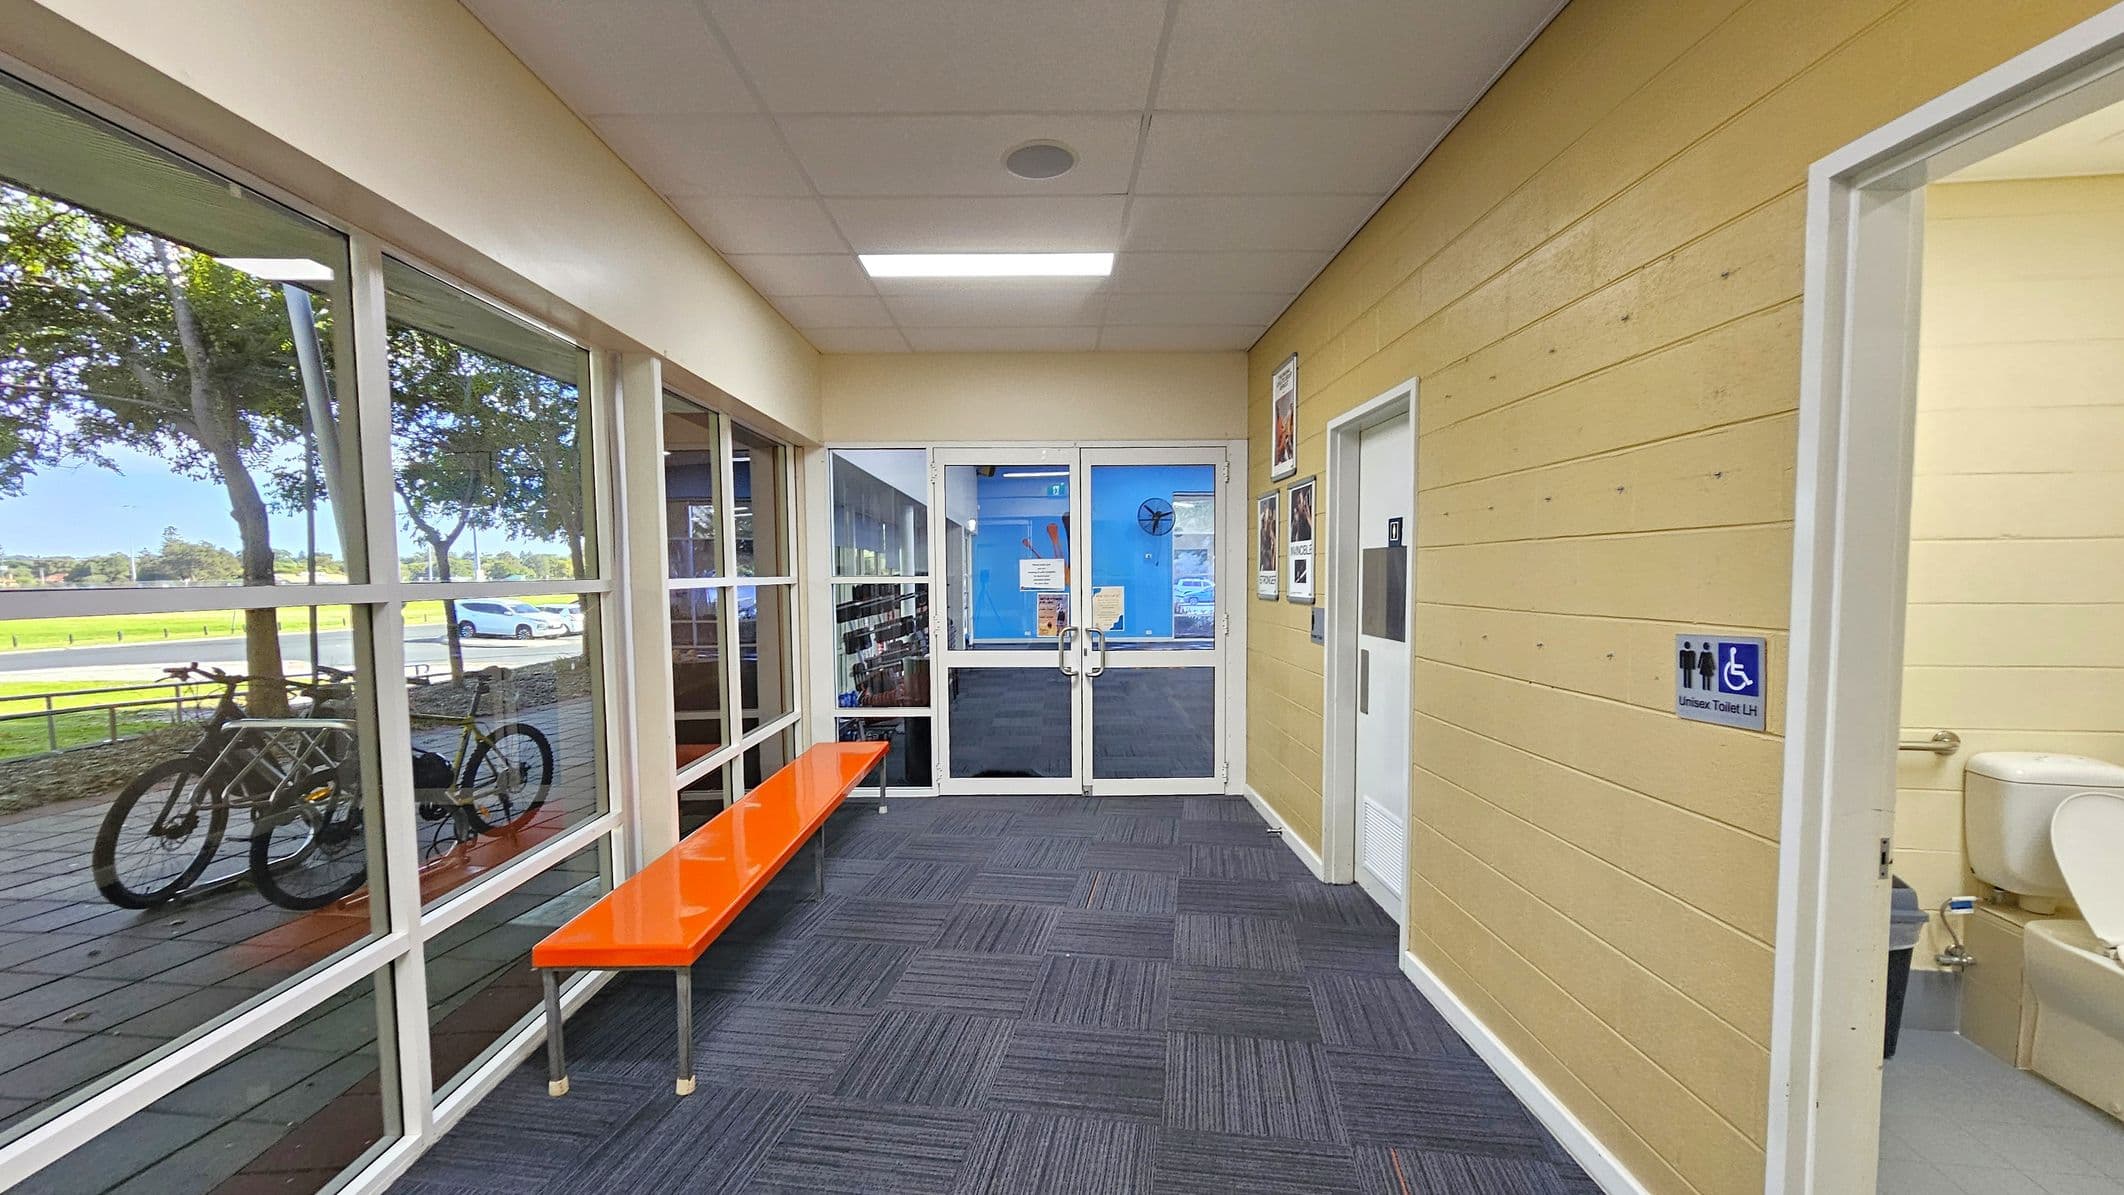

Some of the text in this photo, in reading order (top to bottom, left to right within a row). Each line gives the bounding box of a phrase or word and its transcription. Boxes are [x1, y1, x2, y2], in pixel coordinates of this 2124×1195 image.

[1679, 696, 1757, 716] Unisex Toilet LH
